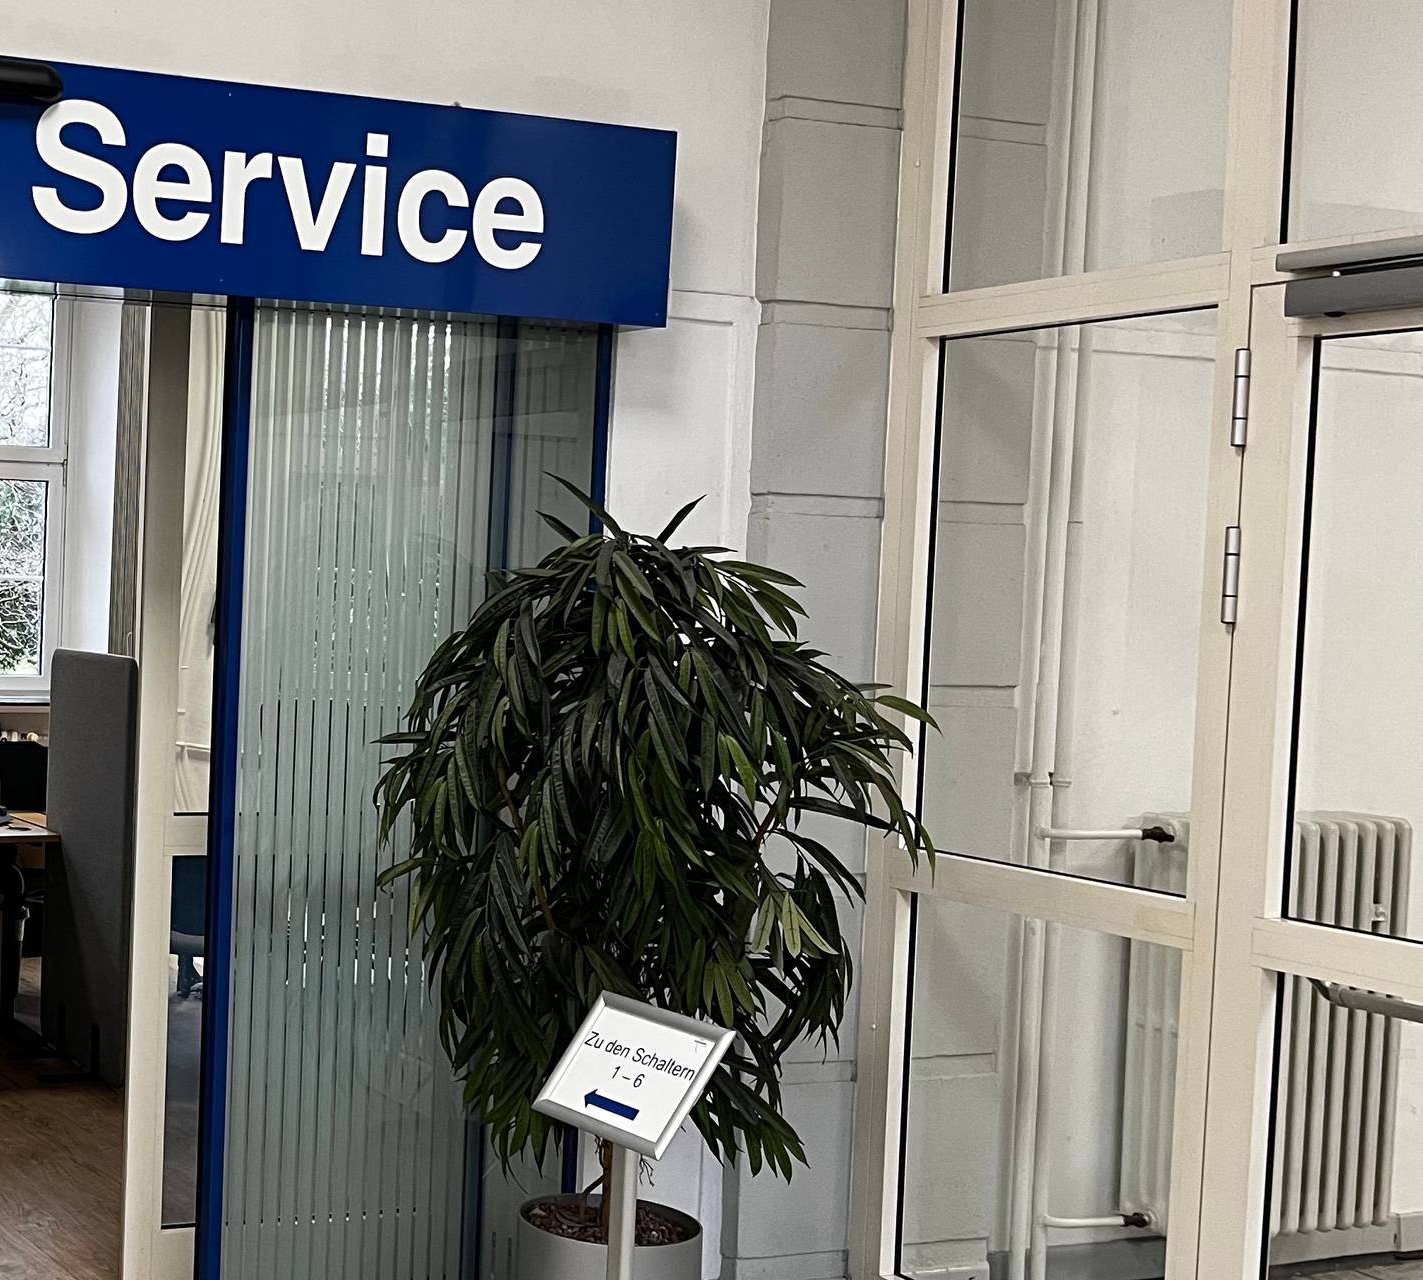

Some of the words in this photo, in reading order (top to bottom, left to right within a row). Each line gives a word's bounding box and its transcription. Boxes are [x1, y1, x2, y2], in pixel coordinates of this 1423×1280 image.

[32, 99, 546, 271] Service
[584, 1032, 605, 1048] Zu
[605, 1040, 632, 1058] den
[632, 1048, 695, 1081] Schaltern
[611, 1066, 621, 1080] 1
[633, 1074, 646, 1088] 6
